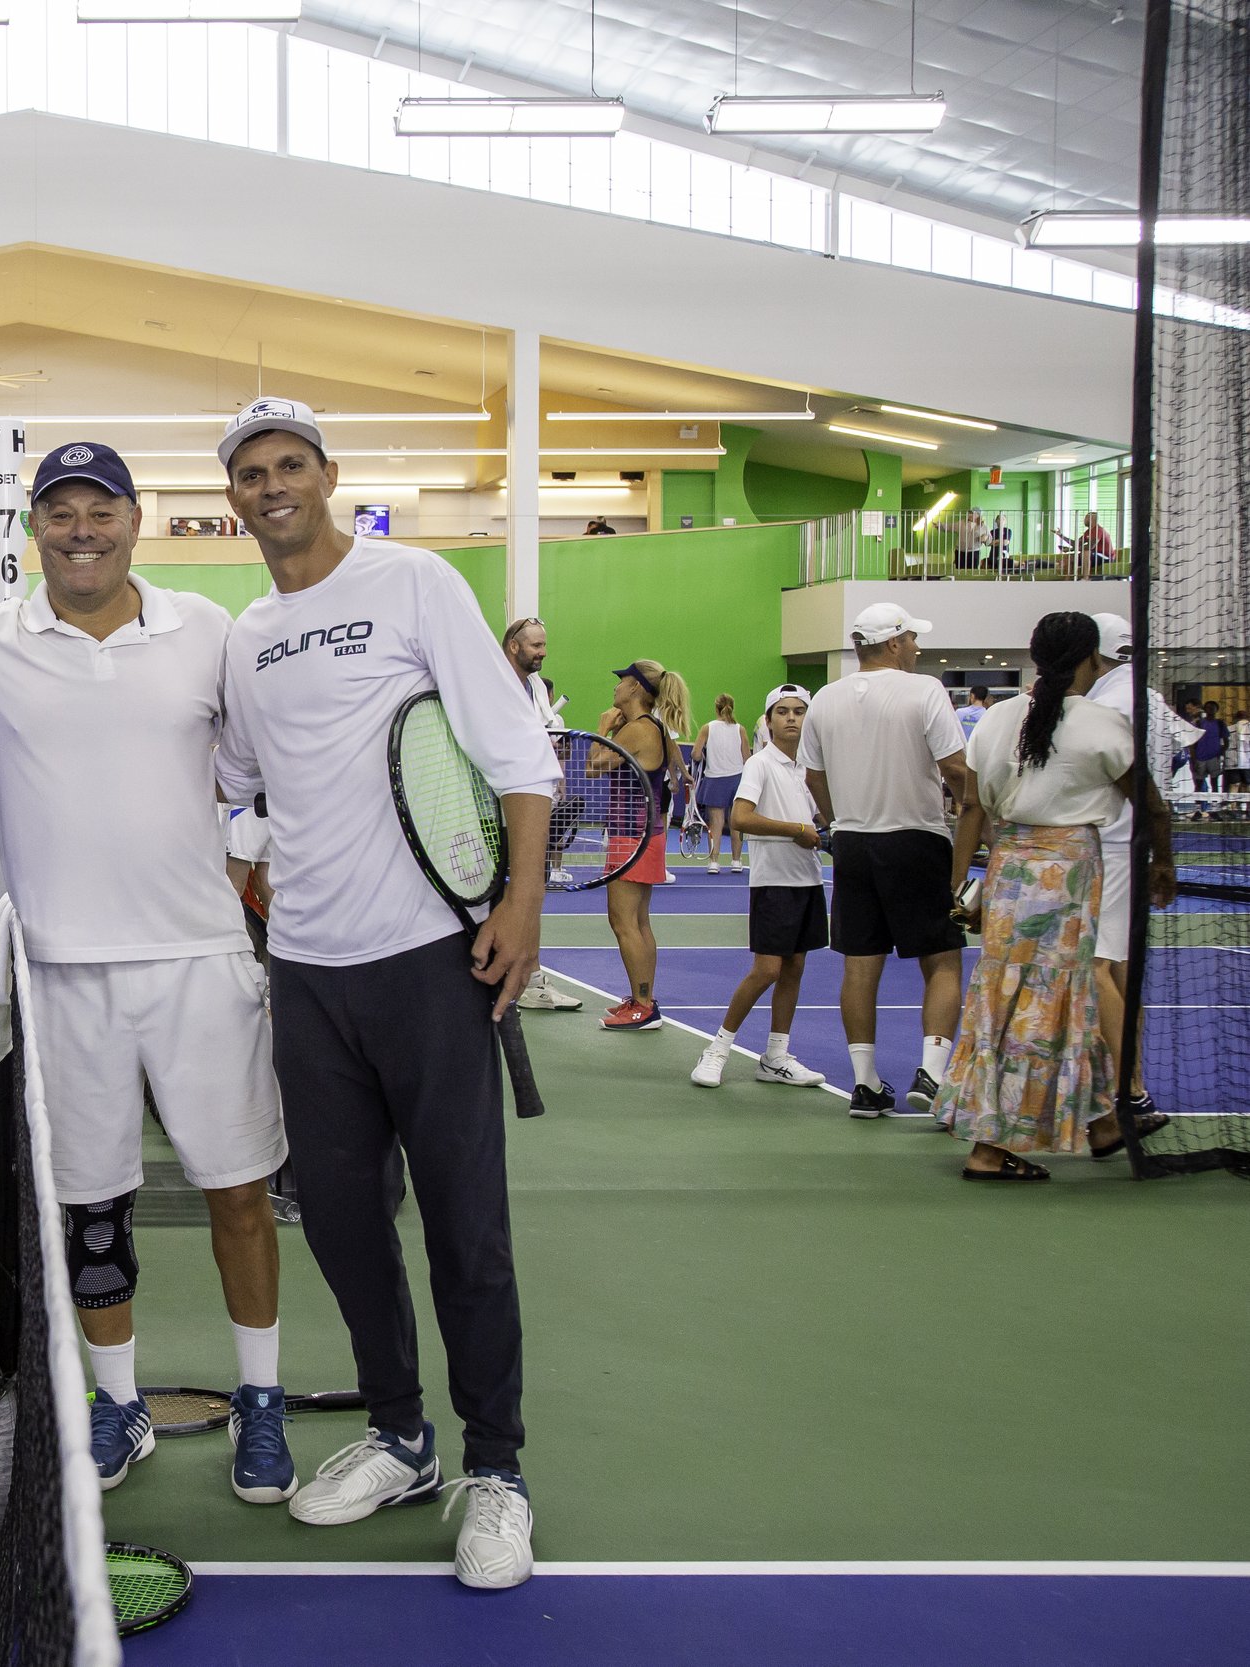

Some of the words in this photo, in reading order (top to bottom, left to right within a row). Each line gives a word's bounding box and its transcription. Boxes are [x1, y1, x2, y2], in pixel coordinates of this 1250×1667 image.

[12, 429, 26, 453] H
[0, 508, 17, 539] 7
[1, 553, 18, 584] 6
[255, 620, 374, 673] SOLINCO
[335, 646, 365, 656] TEAM
